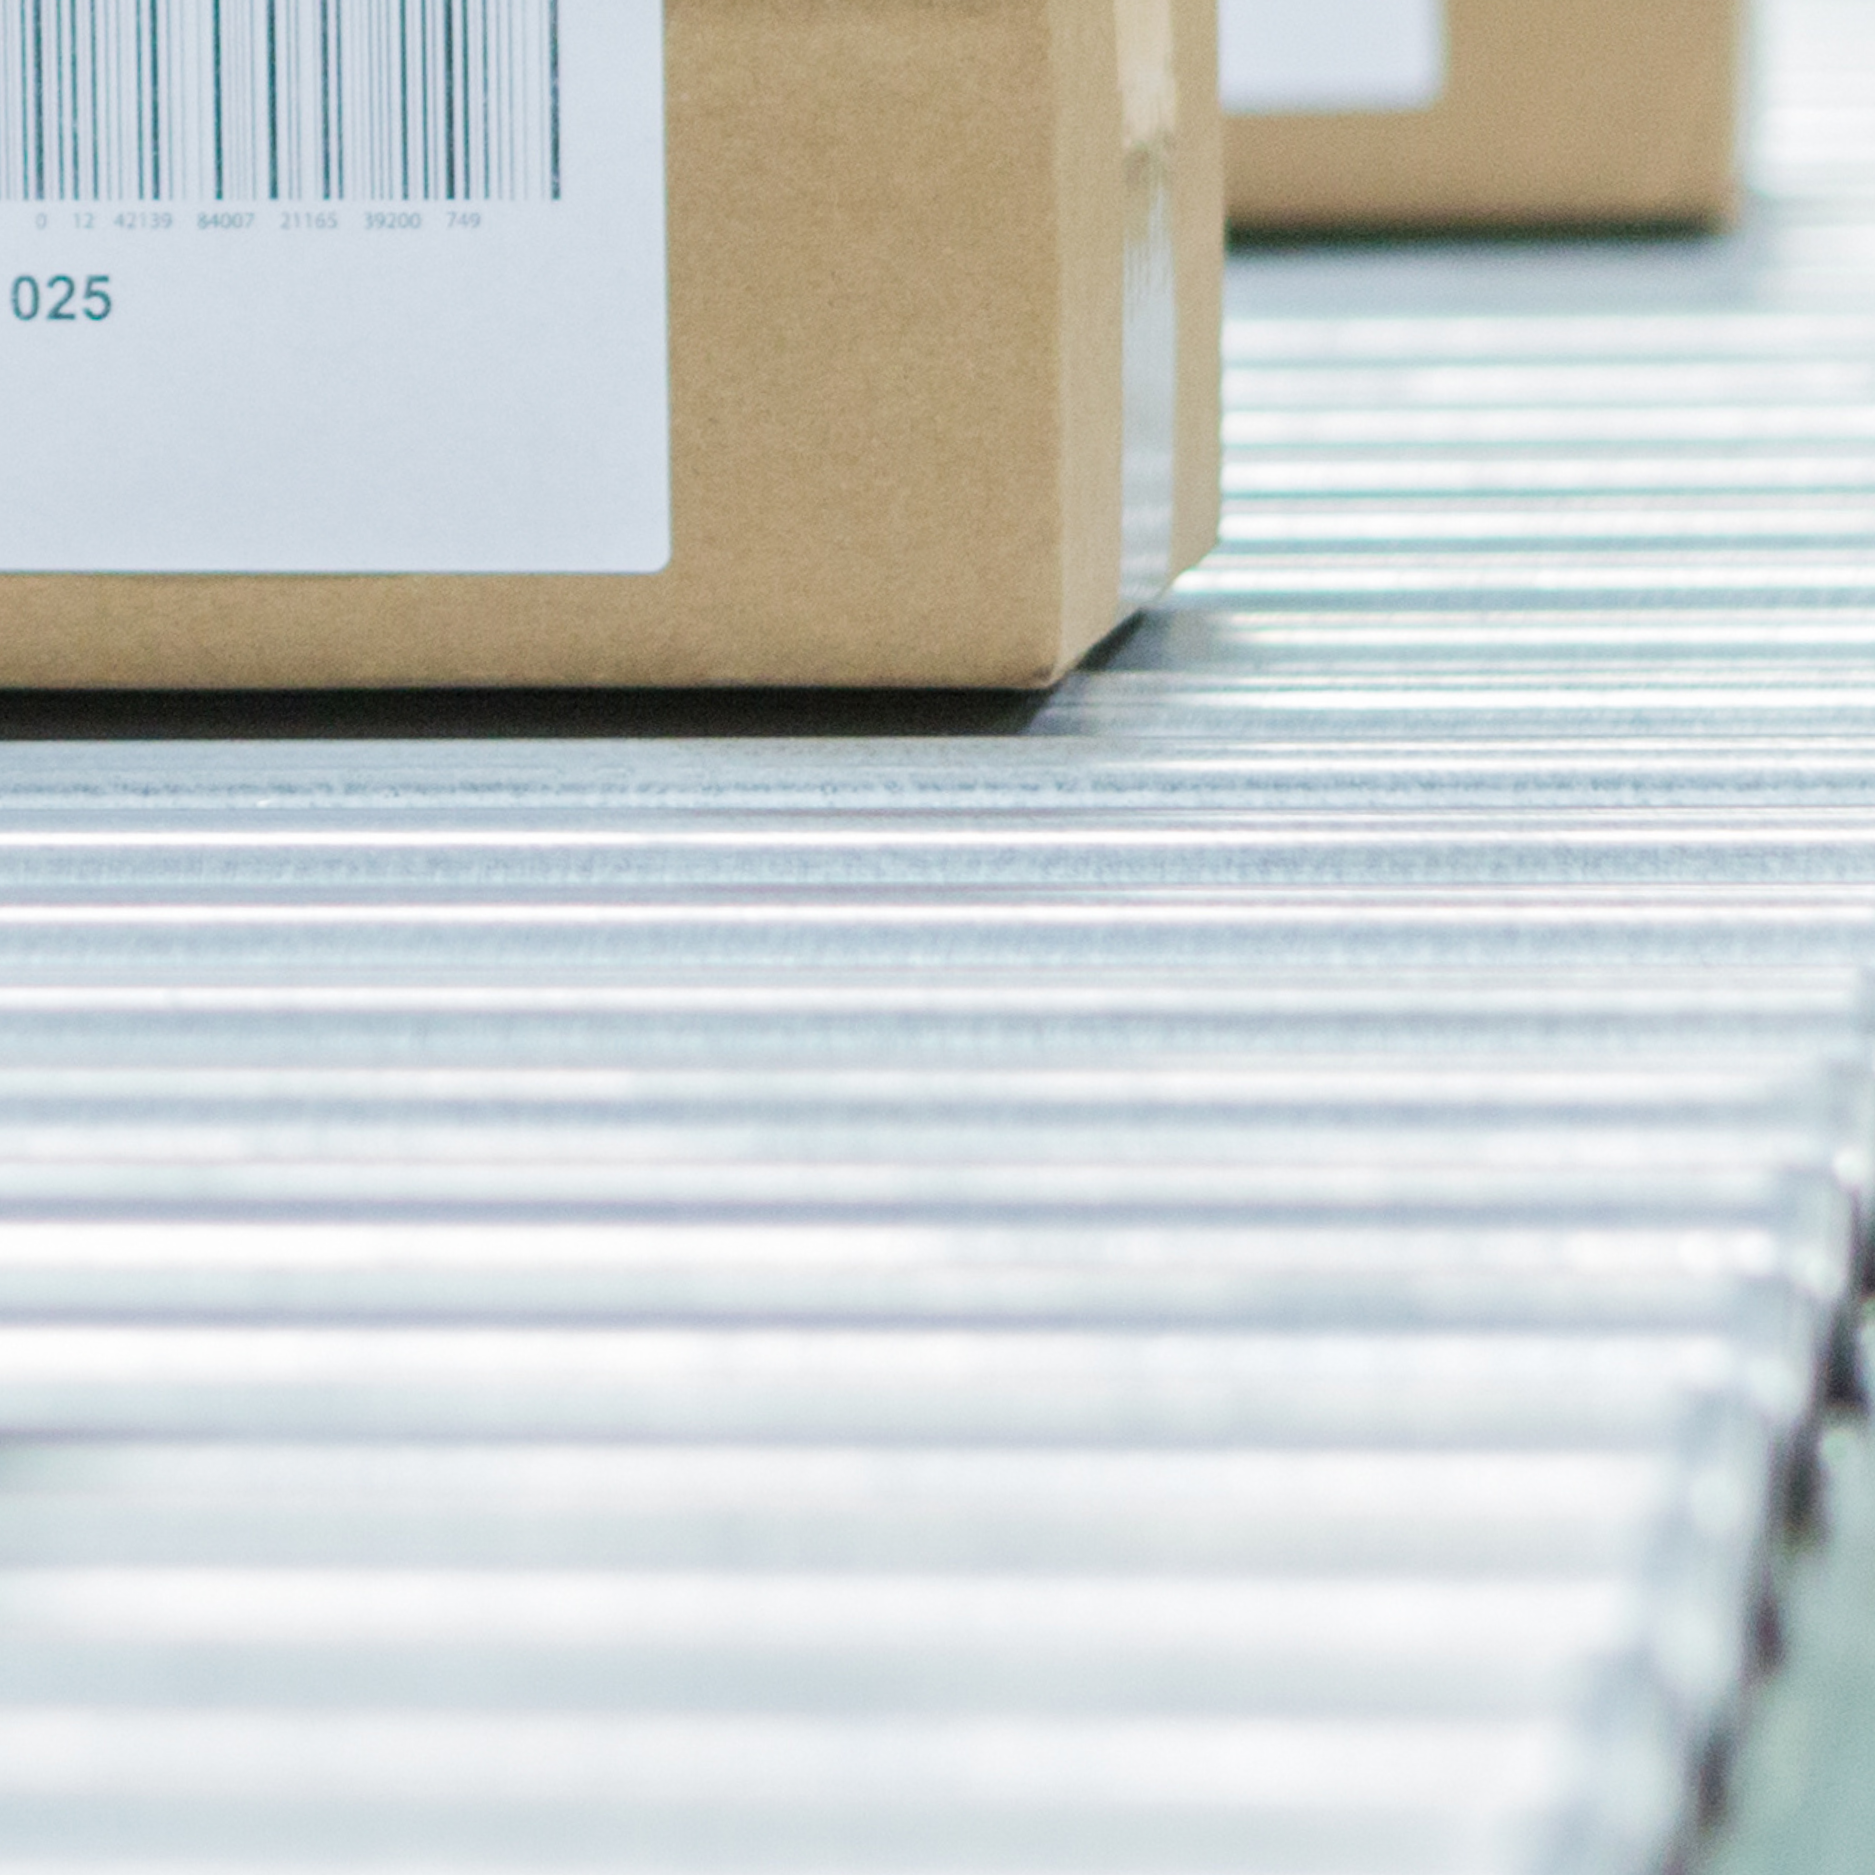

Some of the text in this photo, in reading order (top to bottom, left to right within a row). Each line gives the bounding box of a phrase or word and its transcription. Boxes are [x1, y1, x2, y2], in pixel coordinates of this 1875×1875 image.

[74, 212, 95, 230] 12
[113, 211, 174, 230] 42139
[196, 211, 256, 231] 84007
[280, 211, 339, 230] 21165
[447, 210, 482, 229] 749
[9, 273, 114, 323] 025
